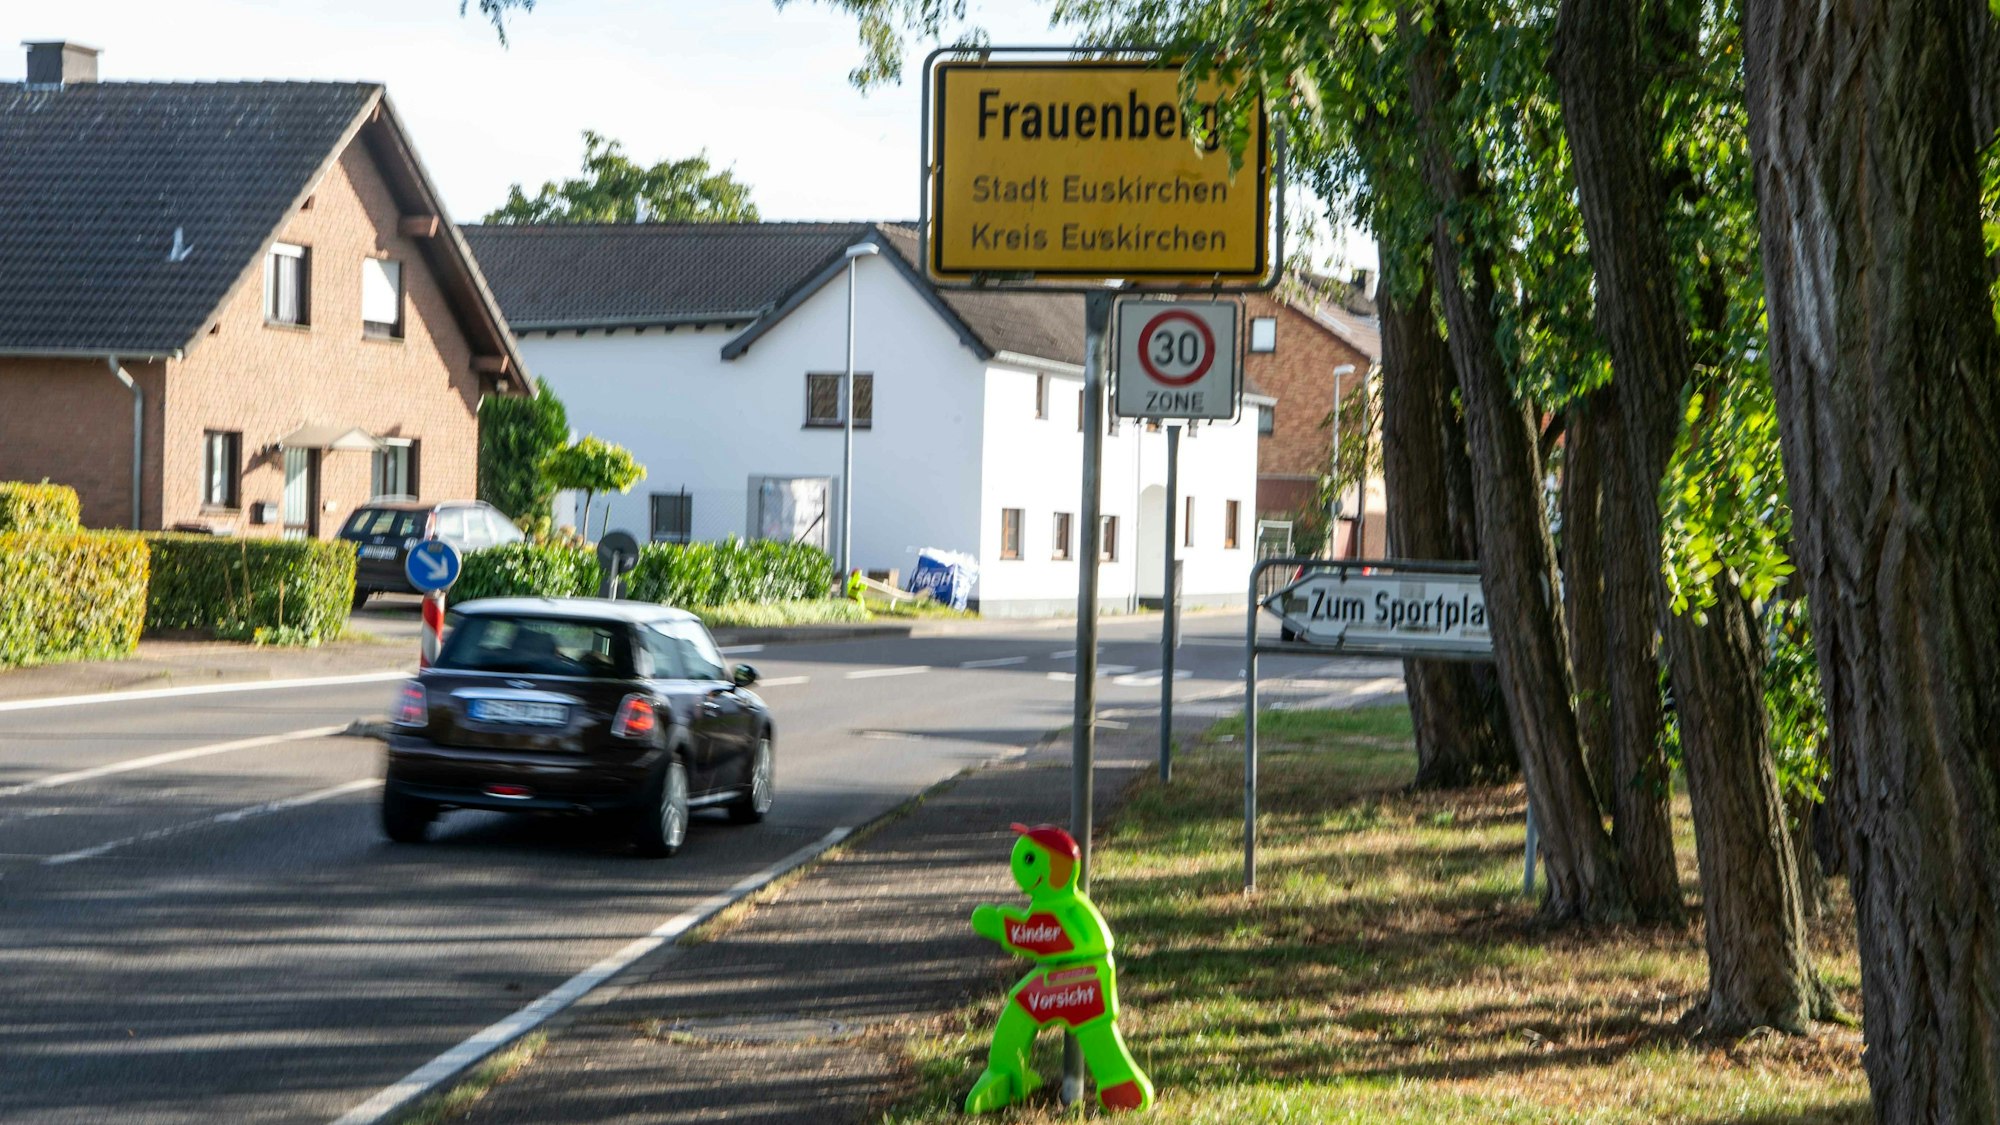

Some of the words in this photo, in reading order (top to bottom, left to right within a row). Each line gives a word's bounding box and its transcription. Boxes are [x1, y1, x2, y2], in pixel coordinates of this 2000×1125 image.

[972, 175, 1049, 203] Stadt
[1062, 175, 1227, 204] Euskirchen
[971, 223, 1048, 250] Kreis
[1061, 224, 1226, 251] Euskirchen
[1153, 330, 1199, 367] 30
[1146, 391, 1204, 412] ZONE
[1311, 587, 1364, 621] Zum
[1010, 922, 1062, 945] Kinder
[1028, 985, 1095, 1012] Vorsicht
